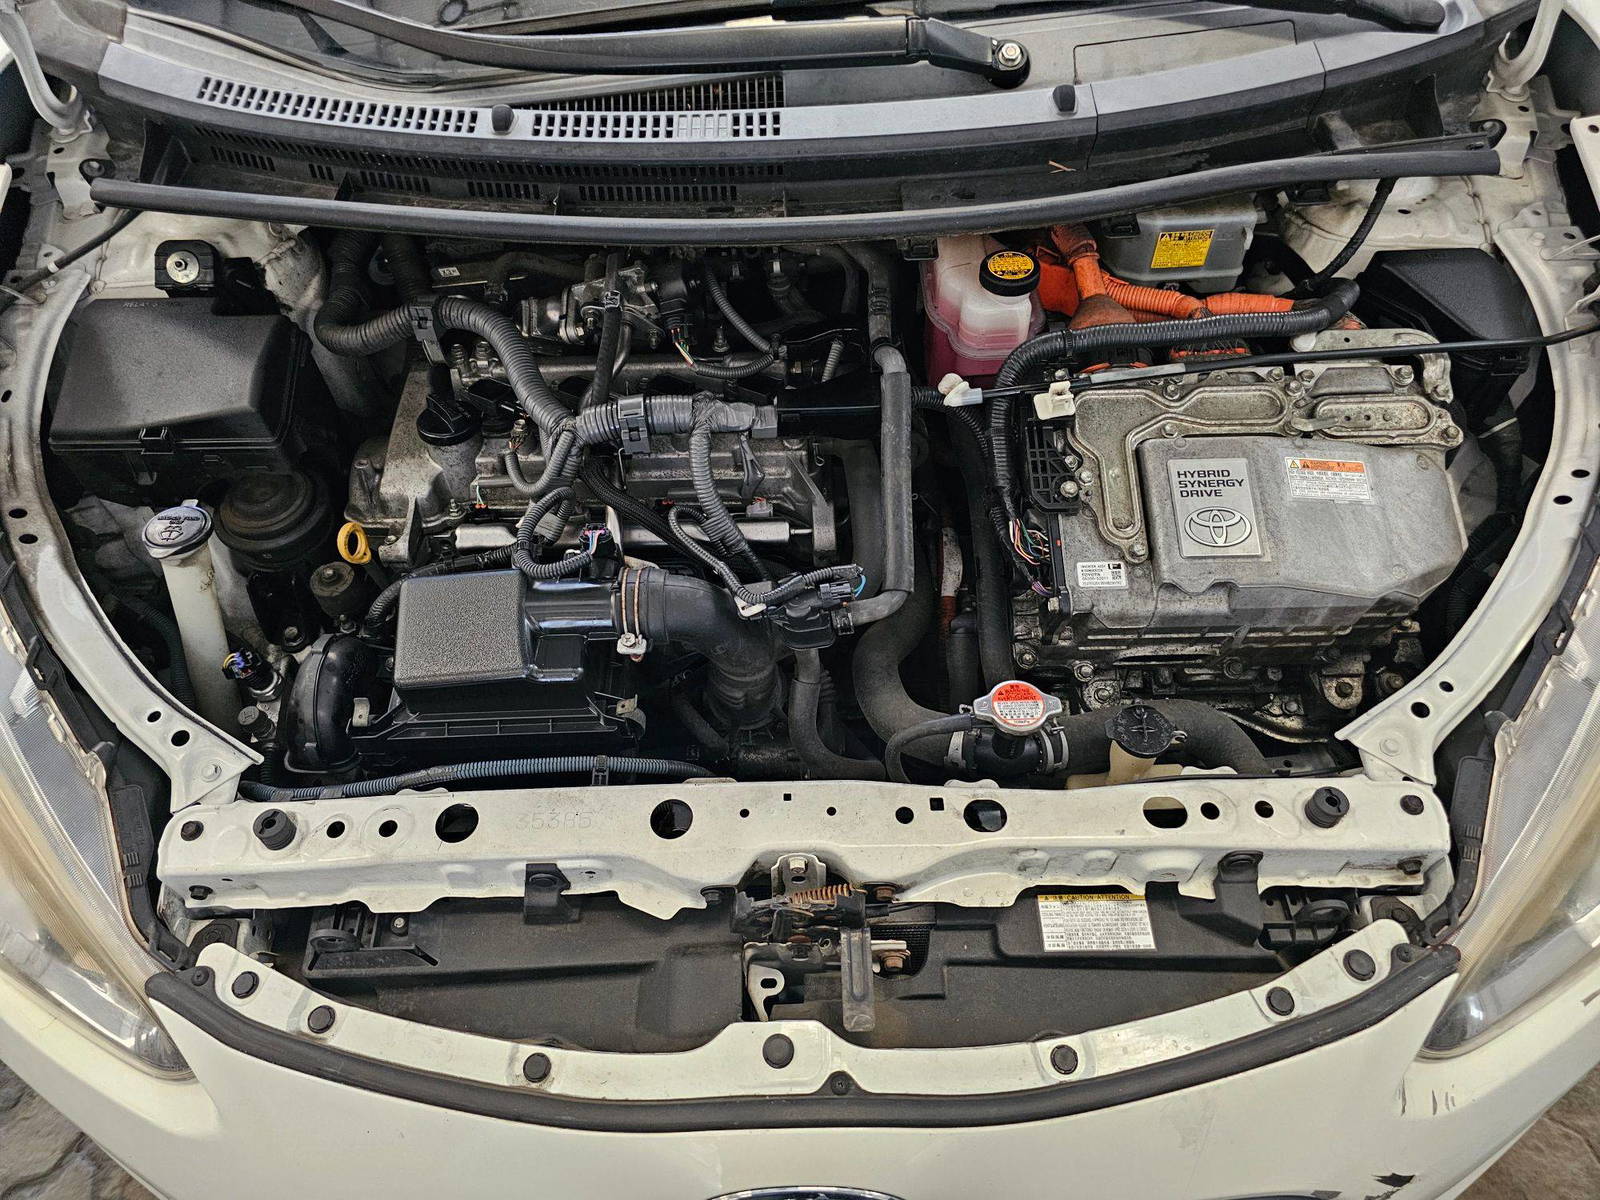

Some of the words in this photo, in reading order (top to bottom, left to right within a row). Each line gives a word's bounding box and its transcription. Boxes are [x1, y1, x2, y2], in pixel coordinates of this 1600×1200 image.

[1177, 469, 1231, 479] HYBRID
[1178, 479, 1245, 488] SYNERGY
[1180, 489, 1223, 498] DRIVE
